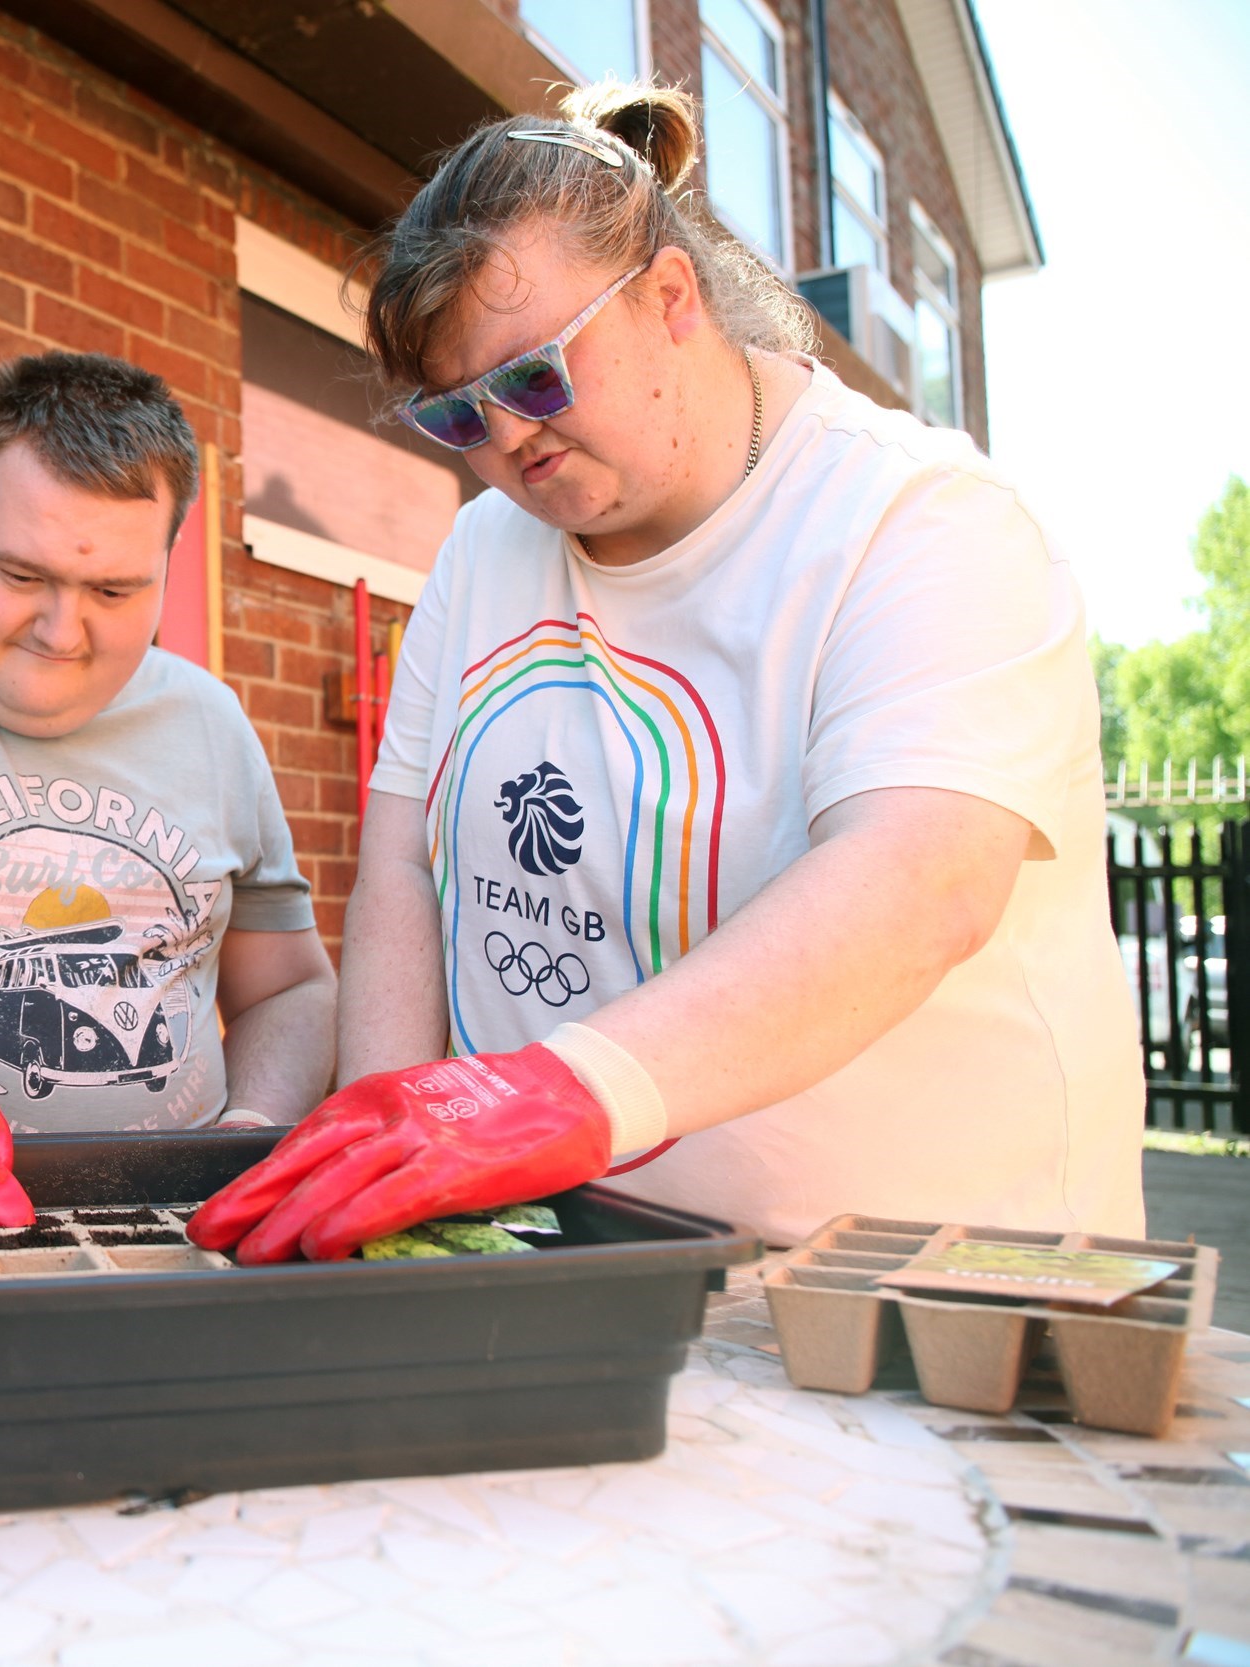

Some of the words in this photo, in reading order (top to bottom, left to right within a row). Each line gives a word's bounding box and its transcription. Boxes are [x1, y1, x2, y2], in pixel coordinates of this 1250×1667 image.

[92, 847, 163, 889] Co.
[473, 875, 549, 926] TEAM
[561, 905, 605, 942] GB
